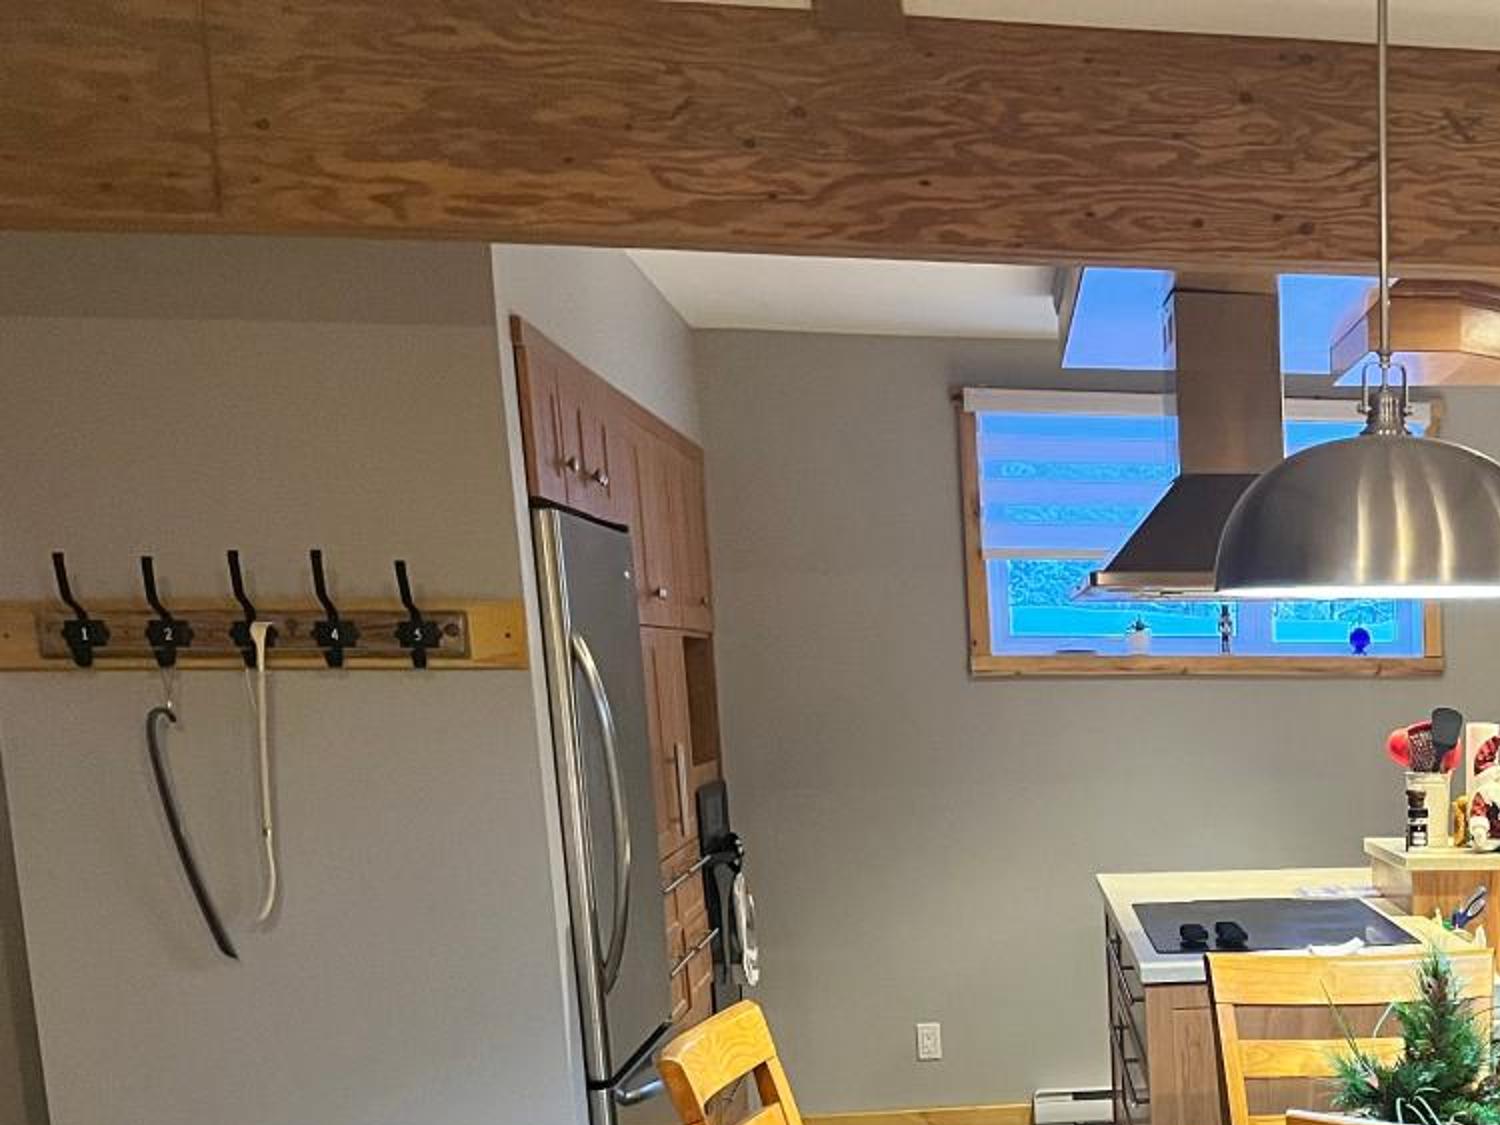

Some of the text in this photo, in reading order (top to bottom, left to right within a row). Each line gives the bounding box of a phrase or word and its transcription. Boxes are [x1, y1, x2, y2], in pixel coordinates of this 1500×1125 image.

[81, 628, 88, 641] 1
[165, 628, 173, 641] 2
[331, 628, 339, 641] 4
[414, 628, 422, 641] 5
